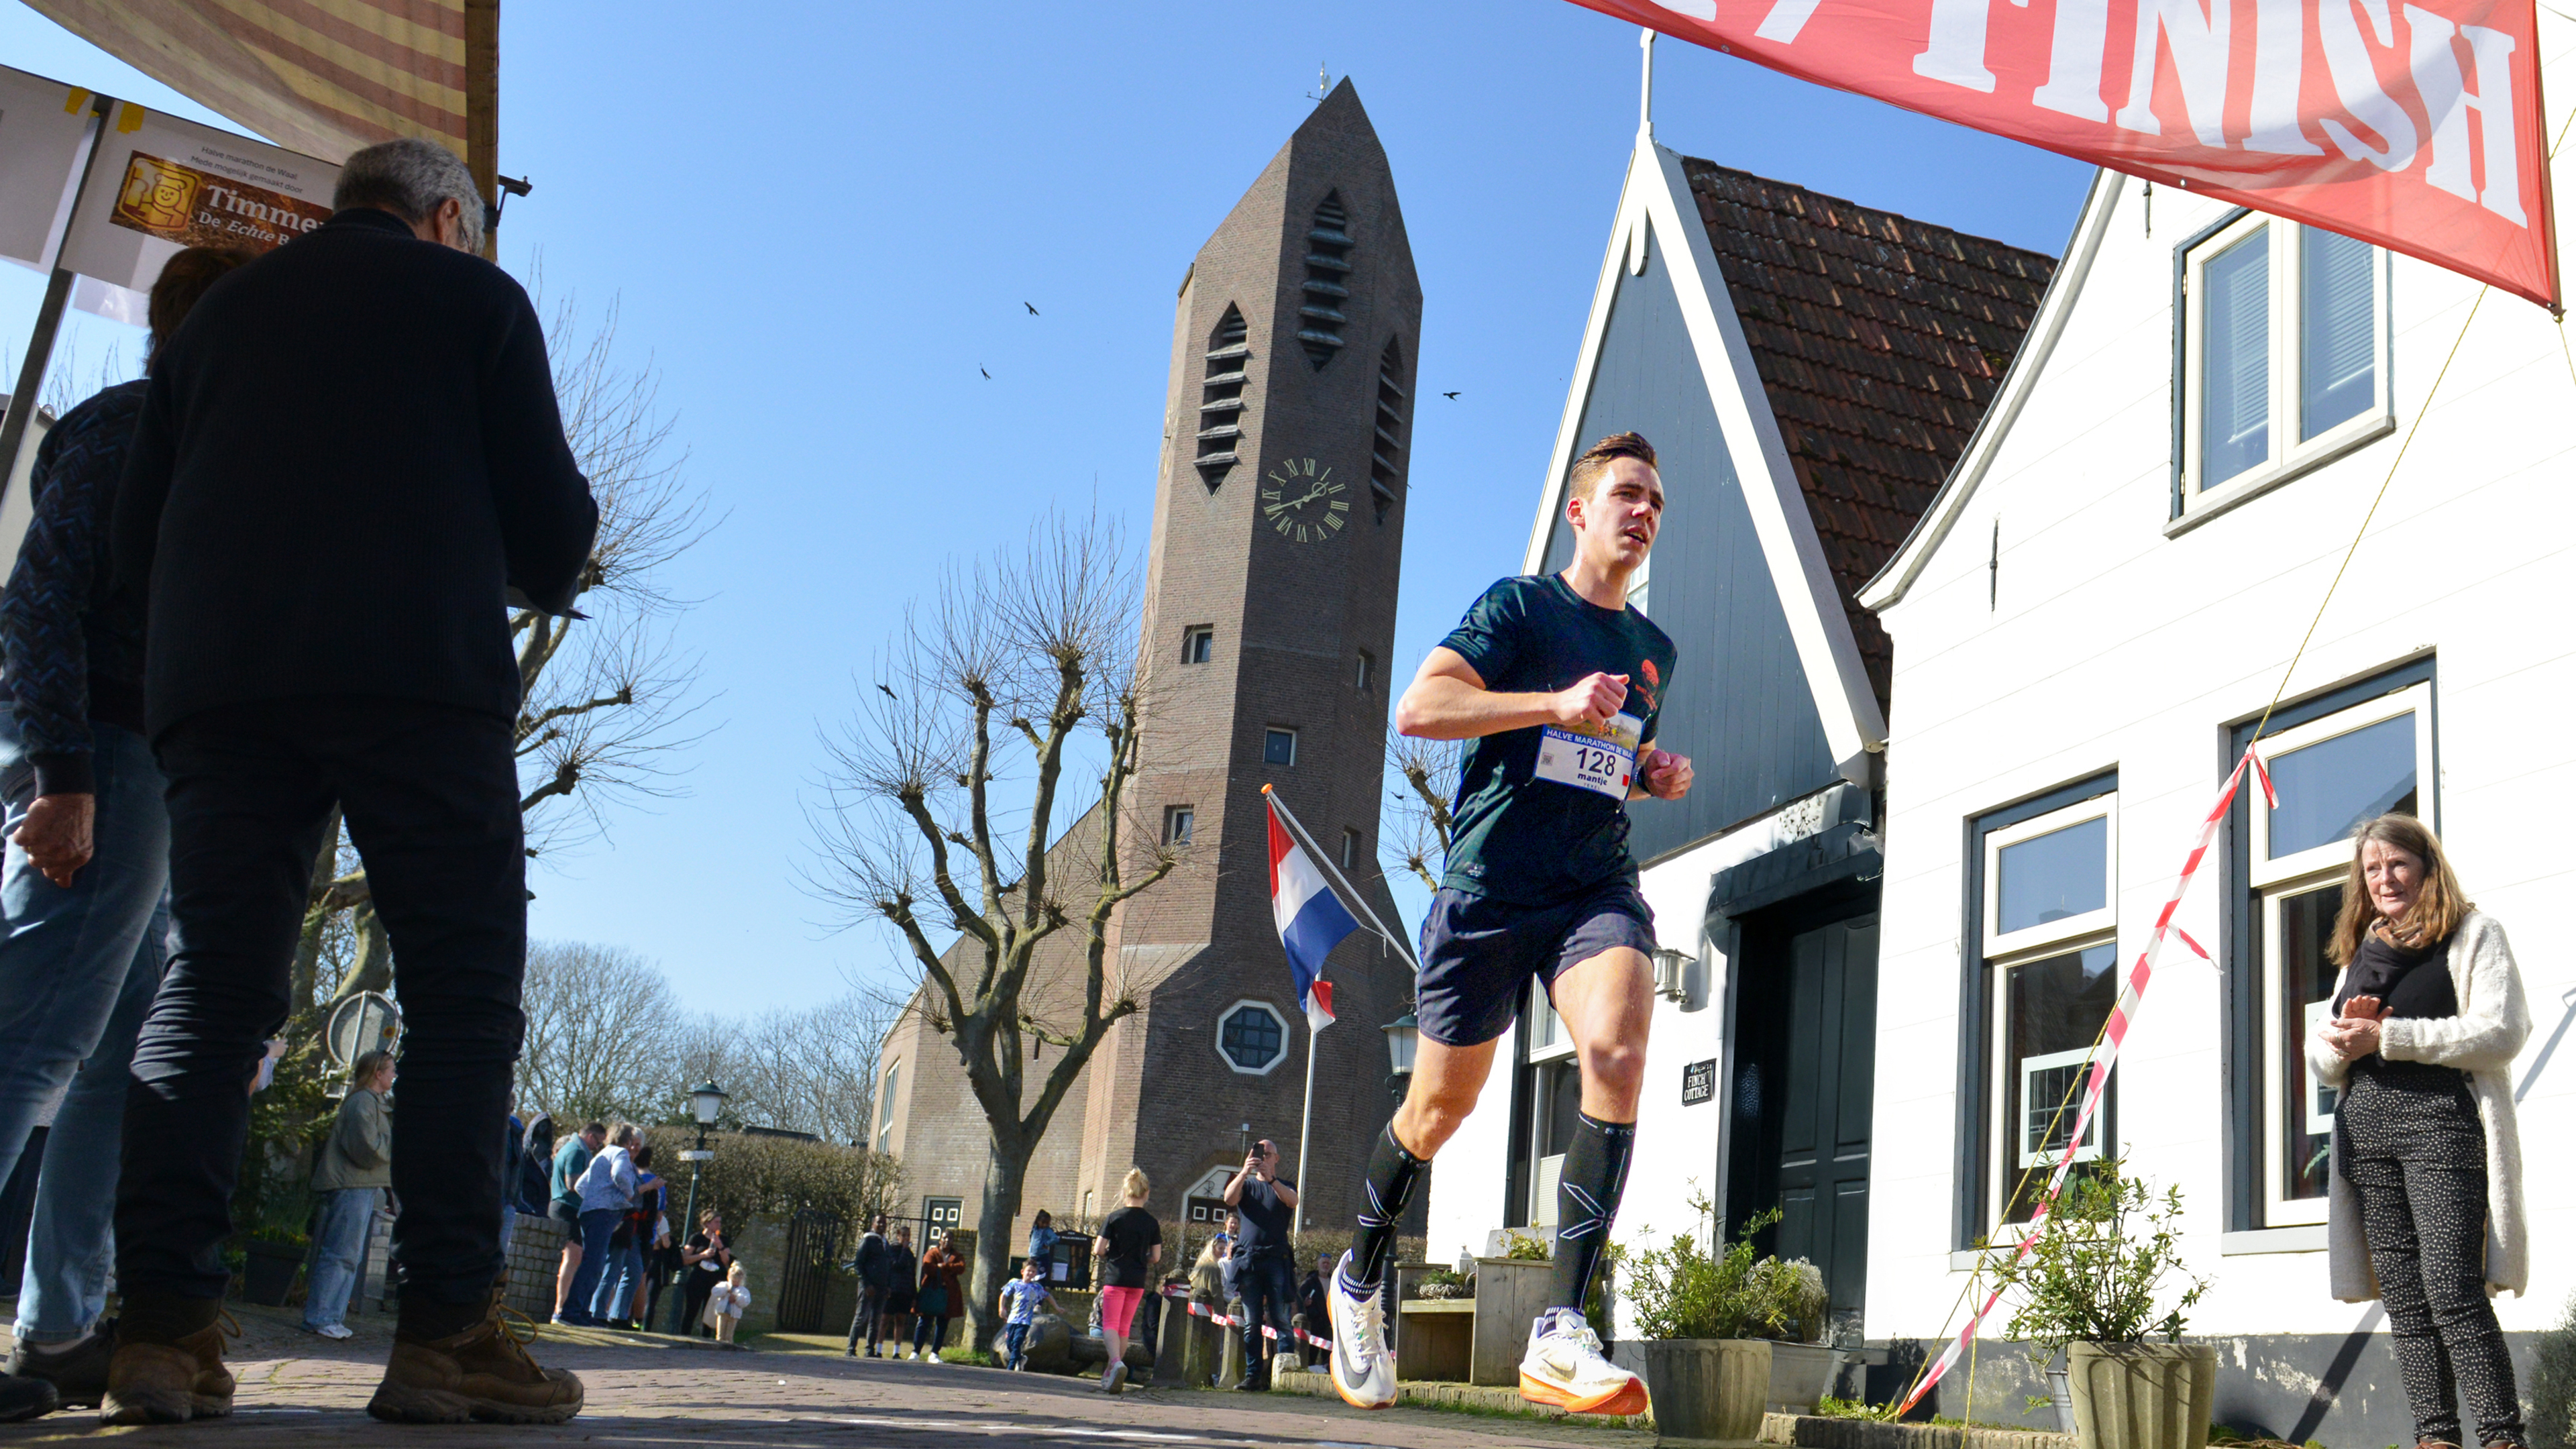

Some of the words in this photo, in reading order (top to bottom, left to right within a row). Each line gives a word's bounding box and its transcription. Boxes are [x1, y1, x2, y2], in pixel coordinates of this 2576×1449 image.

[191, 156, 213, 168] Mede
[215, 163, 247, 178] mogelijk
[249, 174, 284, 188] gemaakt
[284, 183, 303, 193] door
[201, 146, 224, 158] Halve
[226, 154, 264, 170] marathon
[277, 168, 298, 180] Waal
[207, 184, 325, 233] Timme
[199, 211, 221, 227] De
[227, 220, 275, 241] Echte
[1546, 729, 1572, 741] HALVE
[1574, 735, 1615, 751] MARATHON
[1616, 746, 1622, 754] DE
[1621, 749, 1633, 759] WAAL
[1576, 747, 1616, 776] 128
[1578, 773, 1607, 786] mantje
[1684, 1084, 1709, 1101] COTTAGE
[1687, 1073, 1705, 1088] FINCH
